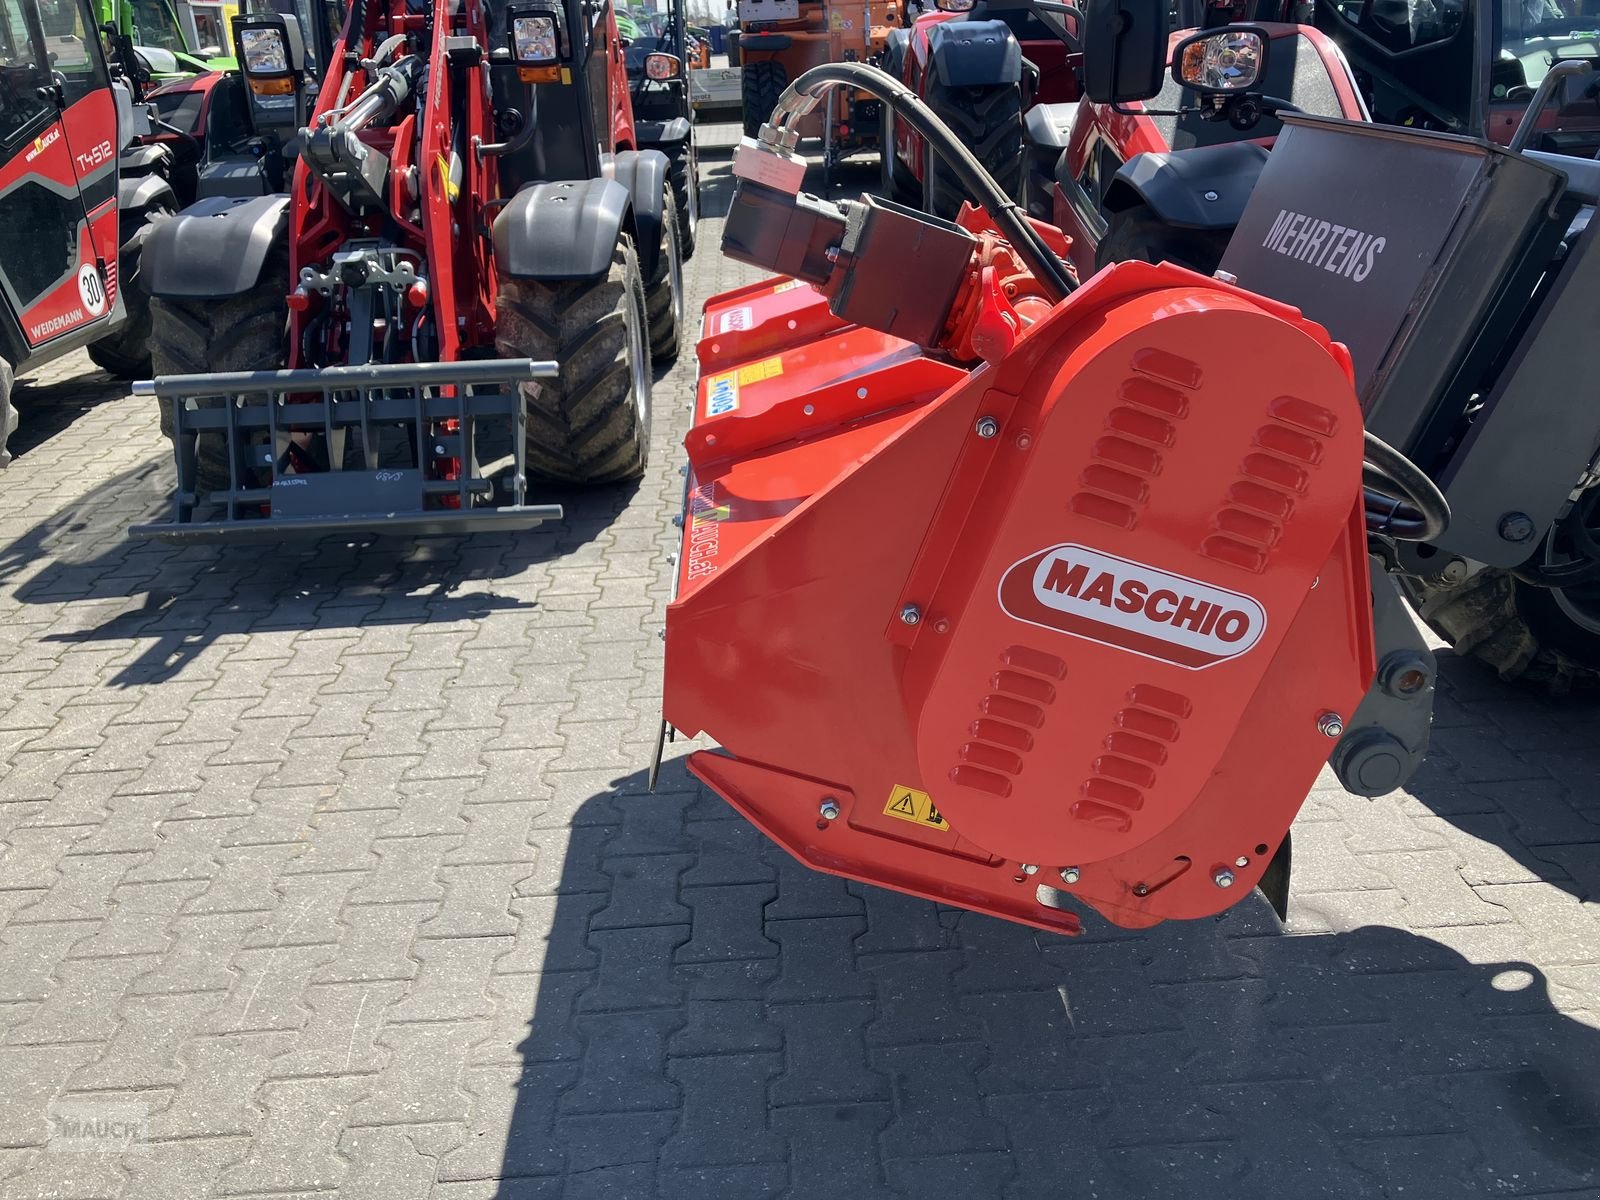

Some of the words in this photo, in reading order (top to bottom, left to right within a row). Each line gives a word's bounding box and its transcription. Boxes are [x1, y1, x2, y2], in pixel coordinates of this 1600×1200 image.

[76, 140, 113, 172] T4512
[1262, 209, 1386, 283] MEHRTENS
[83, 273, 100, 306] 30
[31, 309, 83, 339] WEIDEMANN
[1042, 558, 1250, 643] MASCHIO
